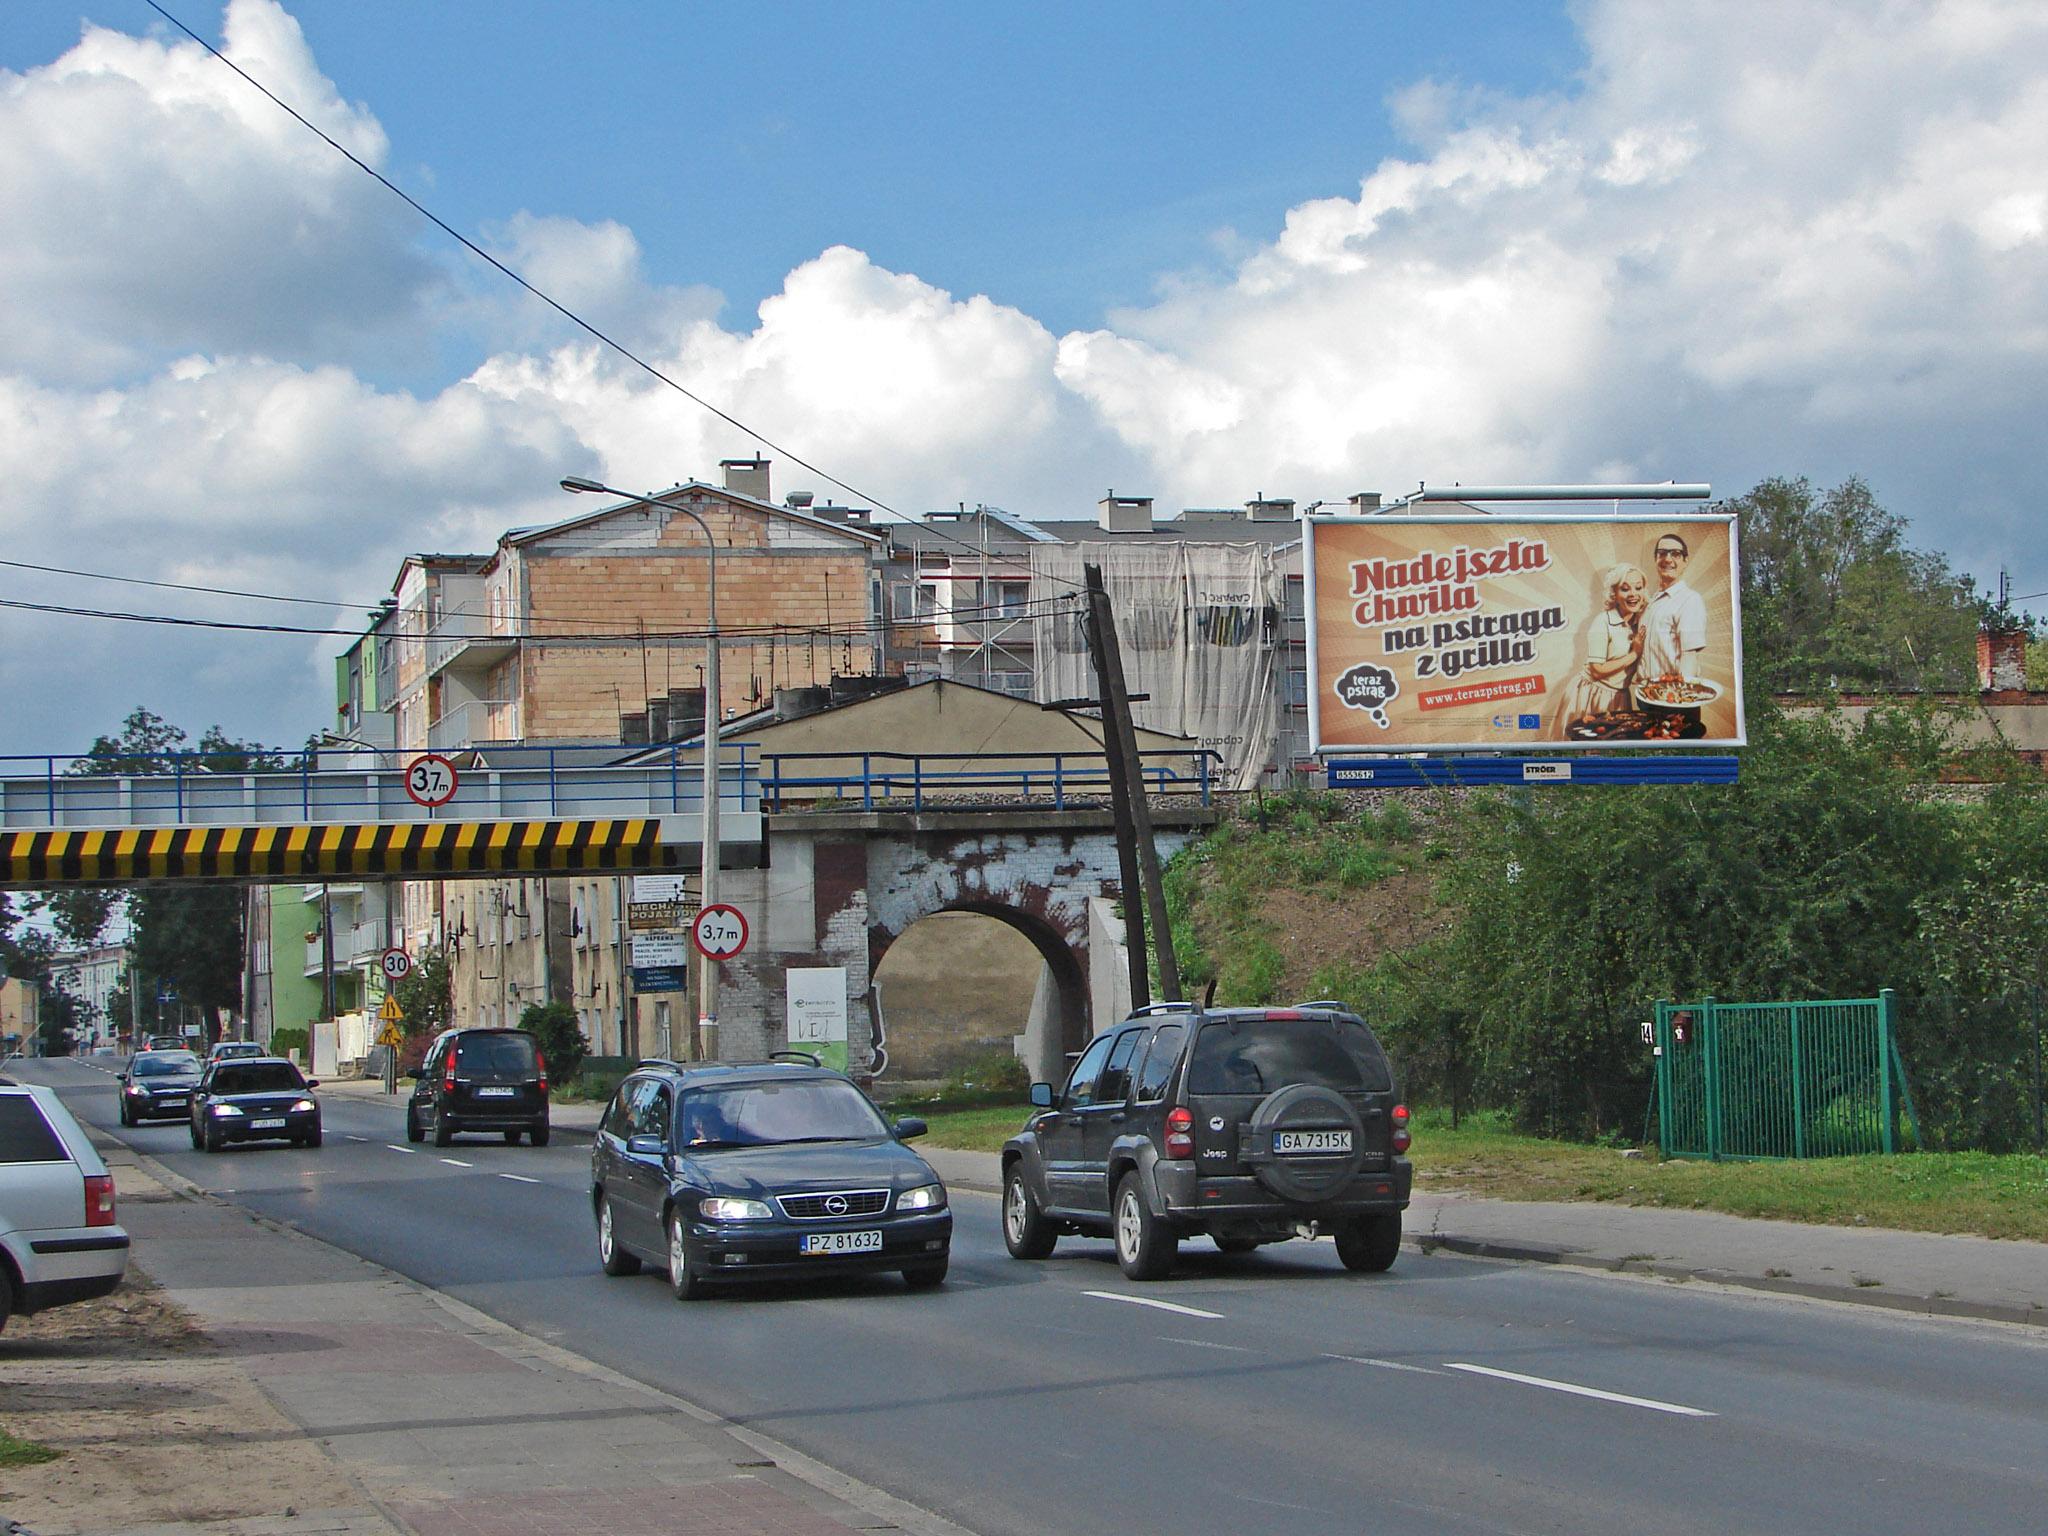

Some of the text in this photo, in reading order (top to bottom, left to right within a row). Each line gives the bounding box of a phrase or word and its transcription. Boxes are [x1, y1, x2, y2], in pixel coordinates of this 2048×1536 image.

[1352, 541, 1549, 594] Nadejszła
[1200, 592, 1250, 602] CAPAROL
[1356, 584, 1480, 624] chwila
[1384, 626, 1429, 651] na
[1417, 655, 1438, 675] z
[1353, 675, 1382, 687] teraz
[1425, 678, 1537, 705] www.terazpstrag.pl
[386, 956, 407, 972] 30
[1282, 1134, 1302, 1148] GA
[1307, 1133, 1349, 1147] 7315K
[1202, 1148, 1227, 1159] Jeep
[810, 1232, 880, 1249] PZ 81632
